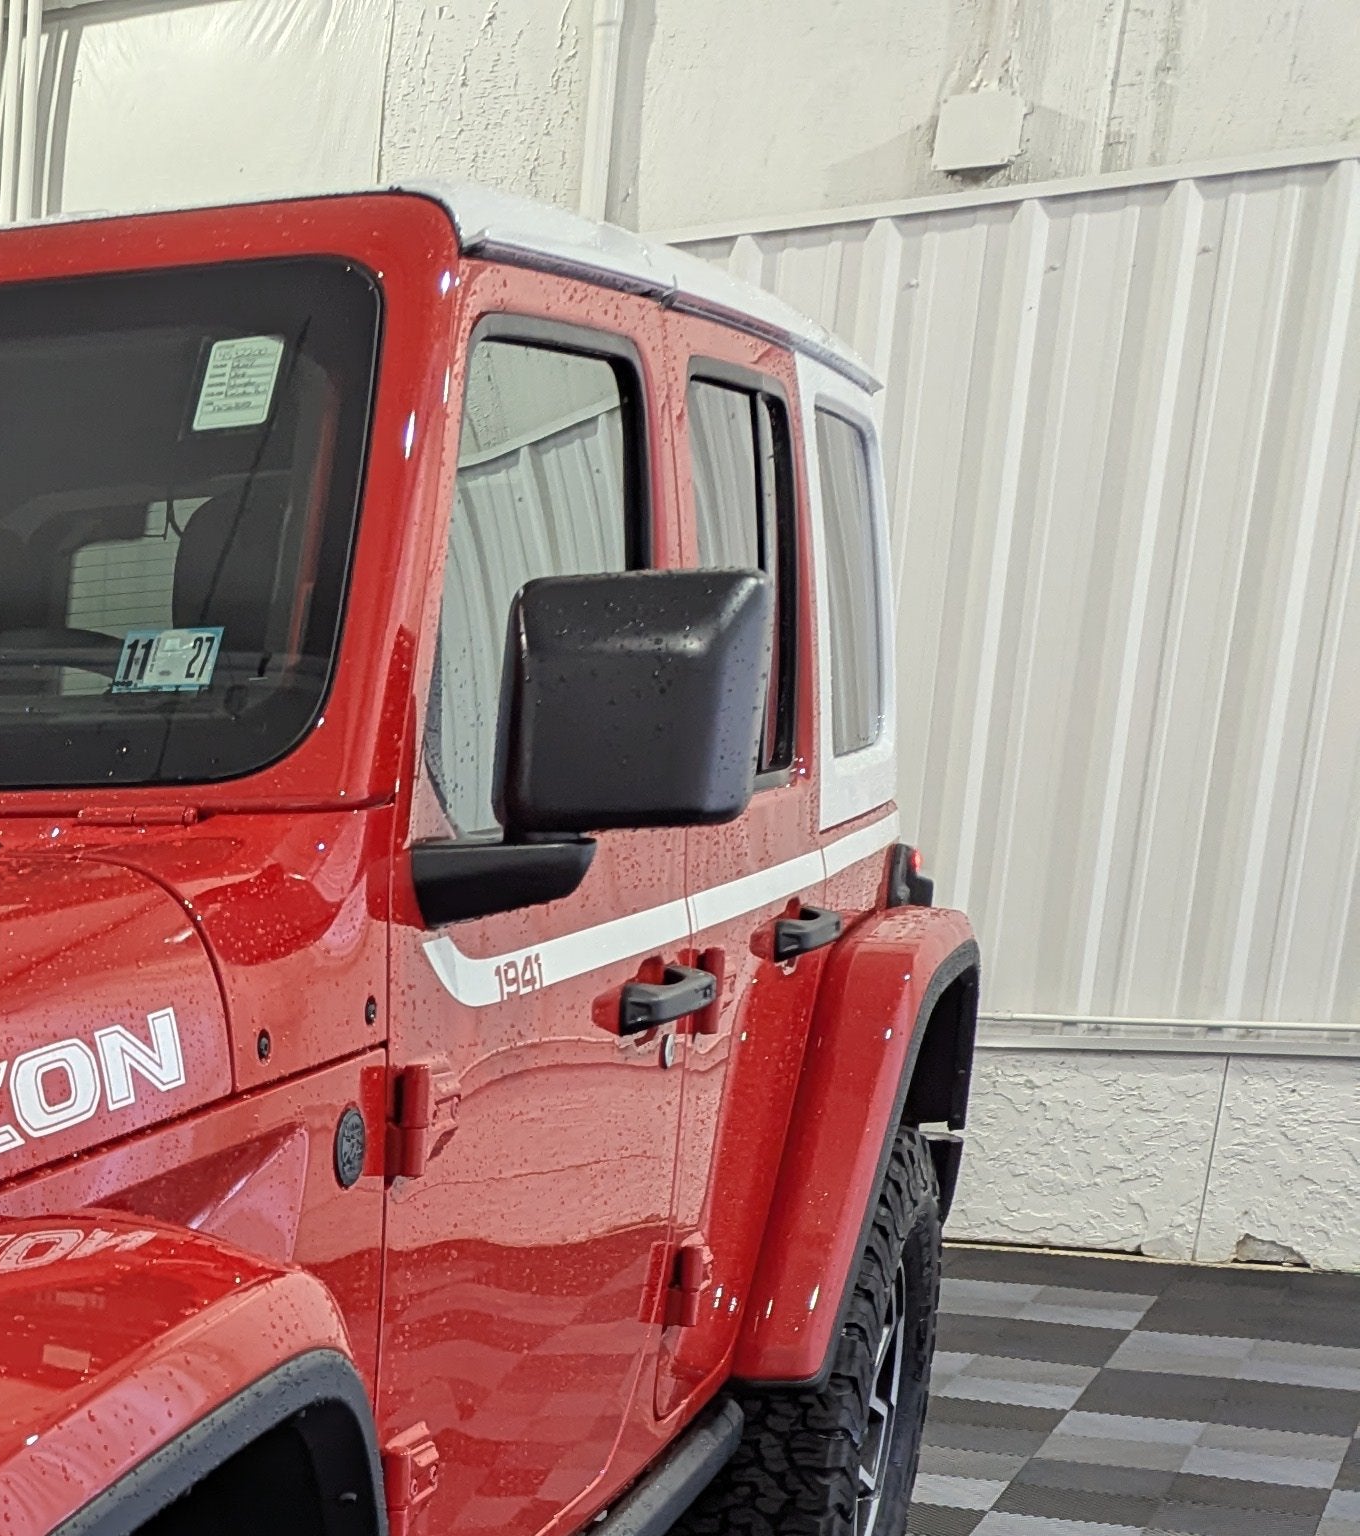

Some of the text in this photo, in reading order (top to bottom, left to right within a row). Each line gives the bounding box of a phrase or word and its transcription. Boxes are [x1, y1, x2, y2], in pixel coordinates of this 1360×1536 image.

[123, 638, 155, 681] 11
[185, 636, 215, 679] 27
[494, 953, 544, 1001] 1941
